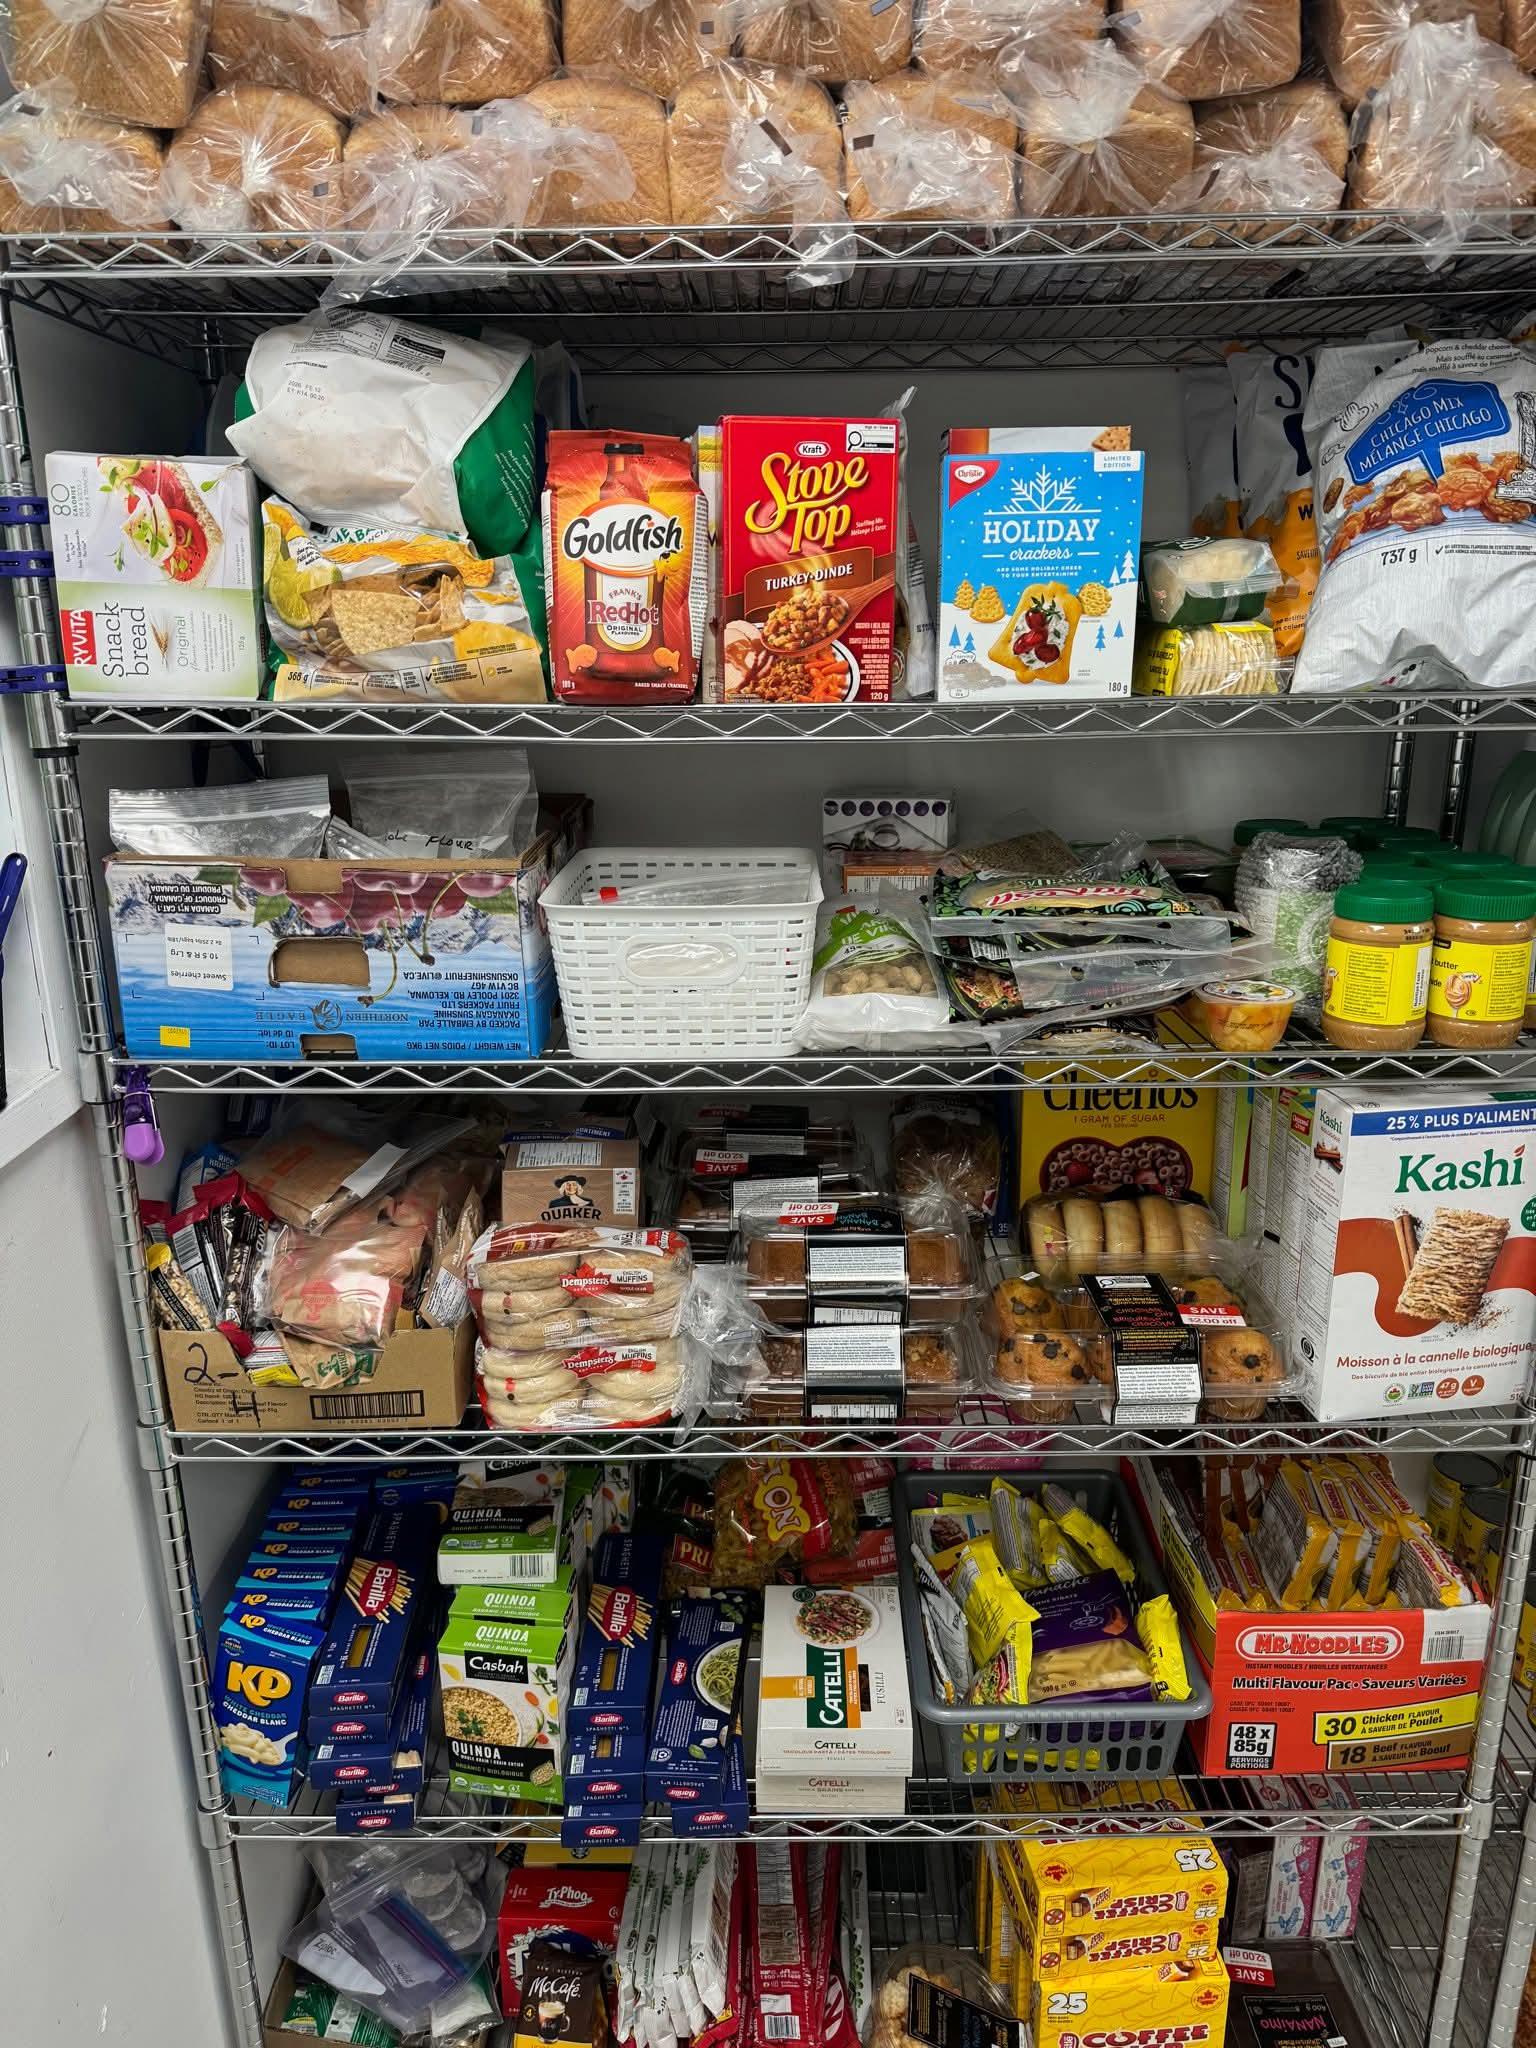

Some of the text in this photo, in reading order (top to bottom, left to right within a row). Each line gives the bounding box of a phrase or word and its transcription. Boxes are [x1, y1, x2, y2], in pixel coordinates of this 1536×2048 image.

[1370, 406, 1432, 448] CHICAGO
[1359, 407, 1492, 473] MÉLANGE CHICAGO
[802, 444, 823, 455] Kraft
[957, 468, 985, 478] Christie
[50, 483, 71, 517] 80
[745, 453, 869, 533] Stove
[783, 500, 852, 554] Top
[983, 519, 1099, 544] HOLIDAY
[564, 515, 683, 560] Goldfish
[1010, 544, 1073, 561] crackers
[1381, 549, 1418, 566] 737 g
[608, 588, 642, 601] FRANK'S
[588, 600, 659, 625] RedHot
[606, 624, 643, 632] ORIGINAL
[96, 601, 124, 679] Snack
[121, 605, 149, 678] bread
[175, 615, 190, 668] Original
[1108, 682, 1121, 693] 180
[870, 692, 882, 700] 120
[151, 884, 222, 894] PRODUIT DU CANADA
[154, 894, 228, 904] PRODUCT OF CANADA
[1435, 960, 1458, 970] butter
[171, 970, 227, 981] Sweet cherries
[444, 972, 519, 980] OKSUNSHINEFRUIT
[471, 982, 519, 990] BC V1W 4G7
[501, 992, 519, 1000] 3201
[346, 1013, 408, 1022] NORTHERN
[476, 1020, 487, 1028] BY
[474, 1042, 505, 1050] WEIGHT
[1080, 1115, 1109, 1124] GRAM
[1131, 1114, 1166, 1122] SUGAR
[1320, 1109, 1343, 1134] Kashi
[1387, 1116, 1406, 1130] 25
[1409, 1115, 1420, 1129] %
[1424, 1112, 1459, 1128] PLUS
[703, 1151, 716, 1159] off
[705, 1164, 738, 1172] SAVE
[1395, 1145, 1526, 1193] Kashi
[541, 1206, 602, 1221] QUAKER
[788, 1203, 832, 1211] $2.00 off
[791, 1215, 824, 1224] SAVE
[562, 1275, 648, 1288] Dempster's MUFFINS
[1190, 1306, 1228, 1315] SAVE
[1222, 1317, 1237, 1325] off
[568, 1353, 652, 1369] Dempster's MUFFINS
[1336, 1342, 1532, 1368] Moisson à la cannelle biologique
[453, 1509, 502, 1521] QUINOA
[277, 1522, 299, 1532] KD
[253, 1567, 277, 1579] KD
[365, 1564, 388, 1613] Barilla
[242, 1594, 267, 1605] KD
[484, 1593, 536, 1607] QUINOA
[240, 1614, 265, 1628] KD
[609, 1591, 633, 1637] Barilla
[263, 1627, 311, 1645] CHEDDAR BLANC
[475, 1625, 530, 1641] QUINOA
[1295, 1632, 1389, 1655] NOODLES
[469, 1656, 524, 1674] Casbah
[227, 1660, 292, 1708] KD
[819, 1651, 844, 1725] CATELLI
[875, 1671, 886, 1704] FUSILLI
[1232, 1673, 1467, 1690] Multi Flavour Pac Saveurs Variées
[338, 1692, 366, 1703] Barilla
[223, 1701, 287, 1726] CHEDDAR BLANC
[225, 1695, 287, 1719] WHITE CHEDDAR
[595, 1715, 620, 1723] Barilla
[1325, 1708, 1440, 1737] 30 Chicken FLAVOUR
[1368, 1715, 1443, 1734] SAVEUR DE Poulet
[1234, 1726, 1270, 1739] 48 x
[452, 1741, 501, 1760] QUINOA
[815, 1741, 856, 1749] CATELLI
[1234, 1739, 1268, 1755] 85g
[1373, 1740, 1432, 1754] Beef FLAVOUR
[1339, 1742, 1451, 1765] 18 SAVEUR DE Boeuf
[339, 1767, 368, 1777] Barilla
[592, 1783, 618, 1792] Barilla
[809, 1779, 849, 1787] CATELLI
[698, 1814, 724, 1822] Barilla
[590, 1827, 616, 1836] Barilla
[1175, 1849, 1216, 1872] 25
[1111, 1893, 1175, 1904] CRISP
[1095, 1904, 1218, 1920] COFFEE 25
[1105, 1934, 1168, 1945] CRISP
[1089, 1946, 1210, 1962] COFFEE 25
[1230, 1952, 1267, 1963] $2.00 off
[1234, 1970, 1265, 1982] SAVE
[528, 1975, 581, 2003] McCafé
[1048, 1992, 1088, 2015] 25
[526, 2008, 532, 2017] 4
[1083, 2024, 1209, 2046] COFFEE
